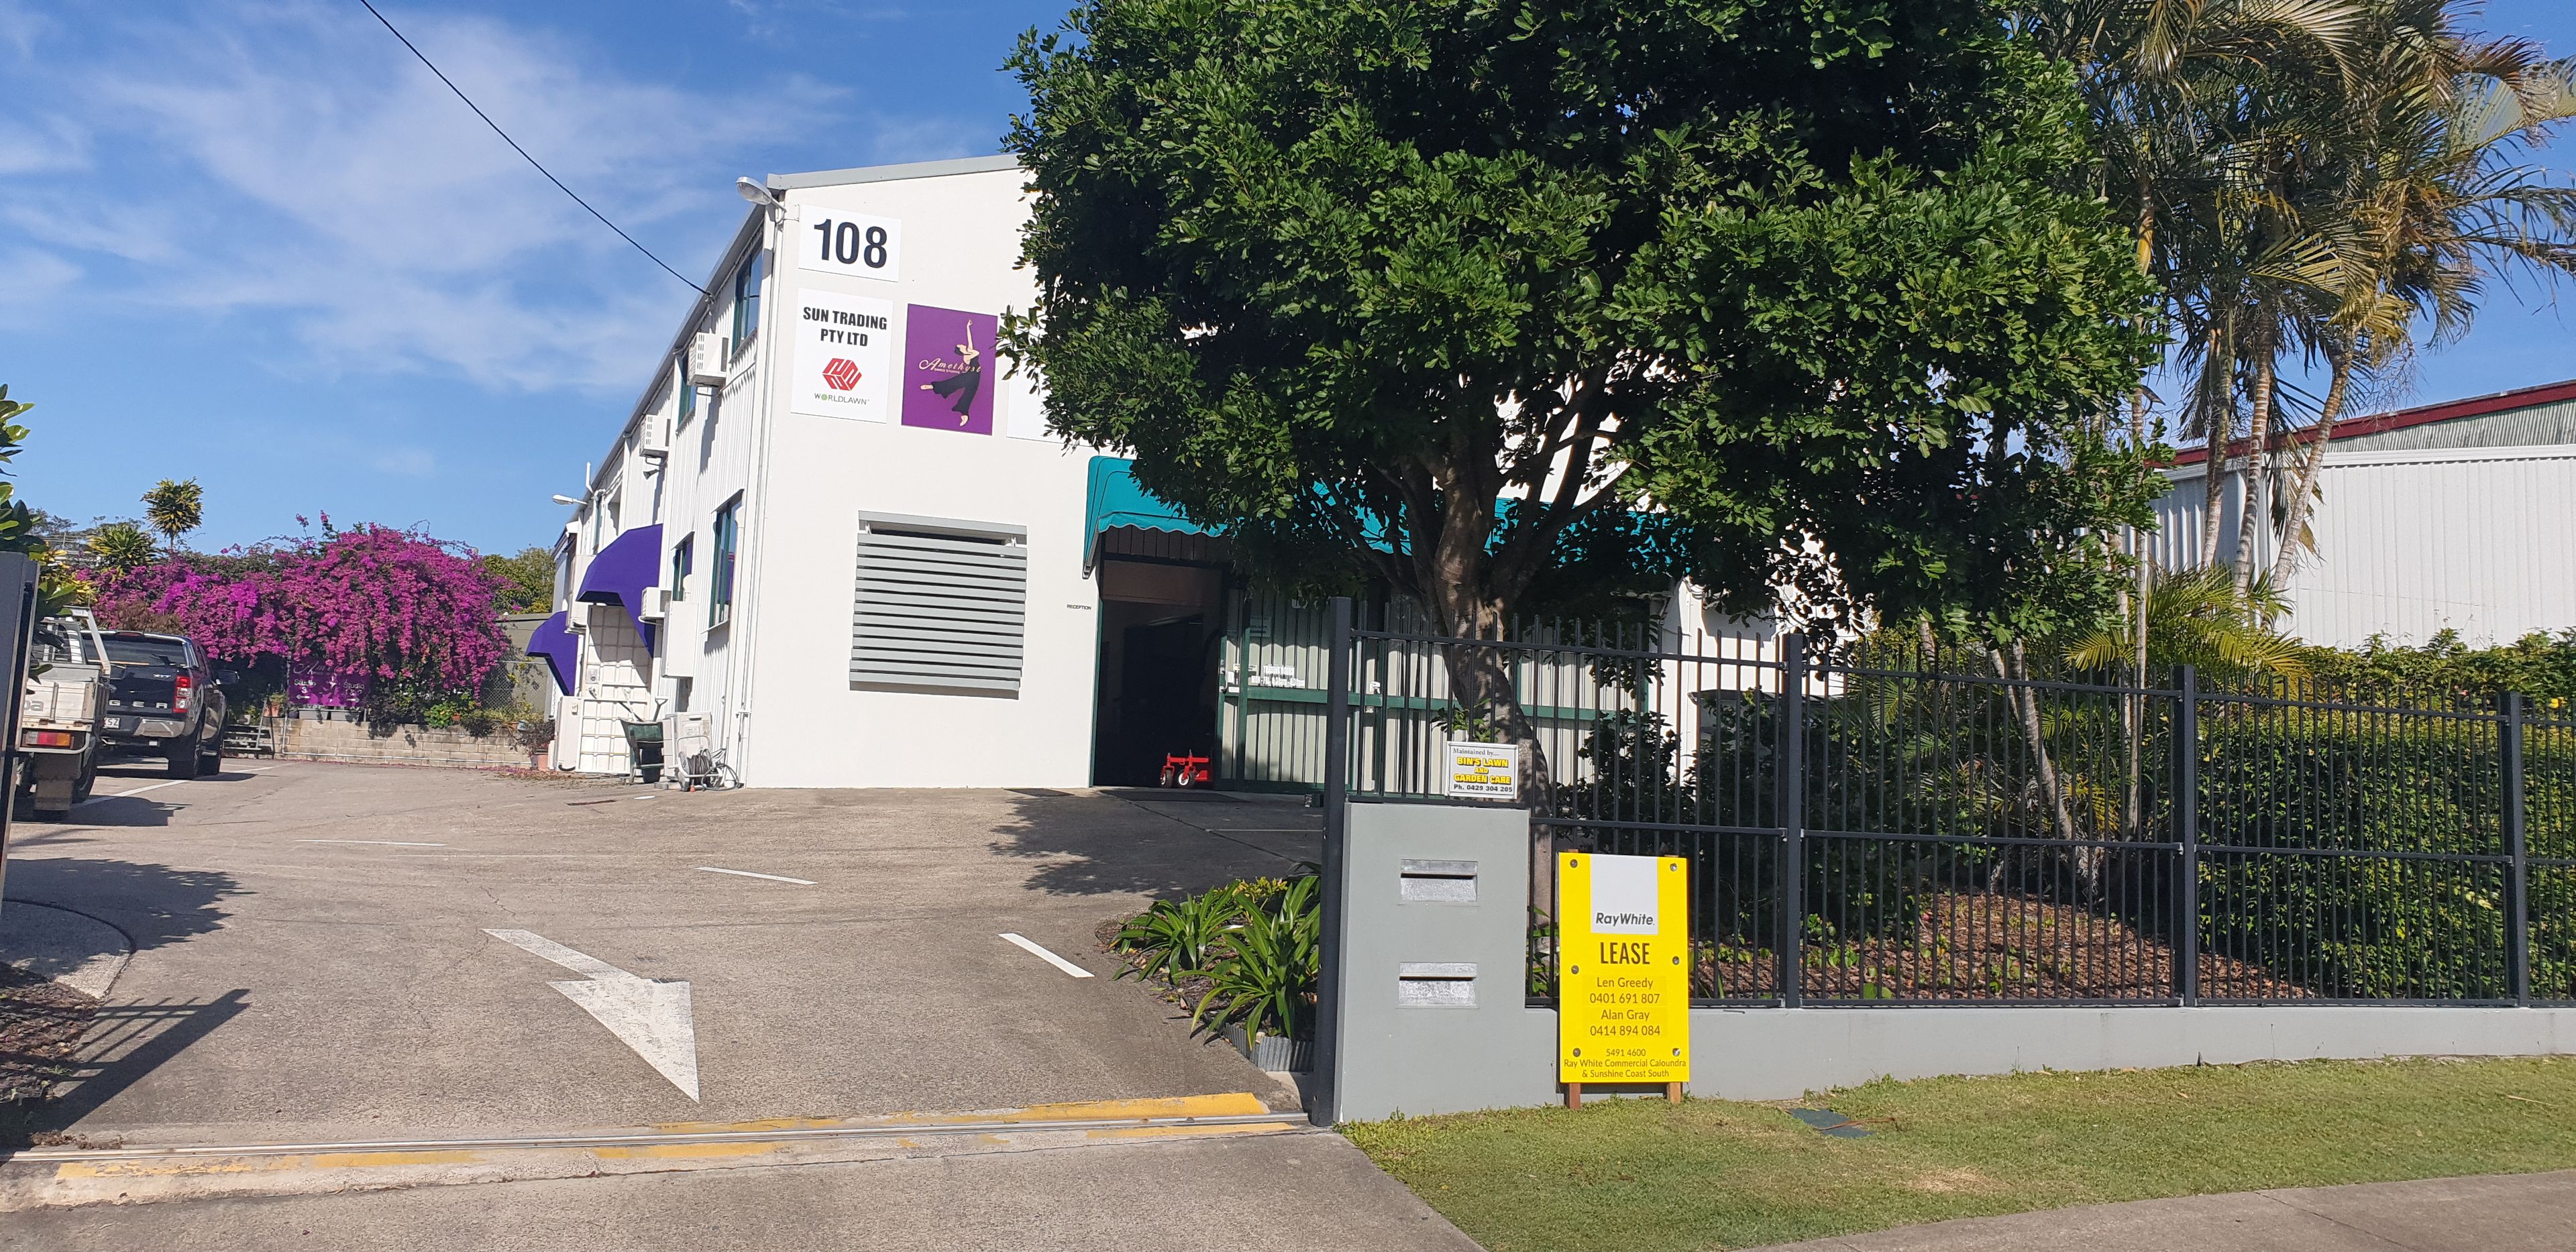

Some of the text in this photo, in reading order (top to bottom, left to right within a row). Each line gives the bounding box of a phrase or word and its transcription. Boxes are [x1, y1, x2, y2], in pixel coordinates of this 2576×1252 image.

[814, 219, 887, 268] 108
[803, 306, 888, 331] SUN TRADING
[820, 328, 868, 347] PTY LTD
[814, 393, 867, 405] WORLDLAWN
[294, 679, 317, 687] Studio
[343, 681, 365, 689] Studio
[1453, 748, 1485, 756] Maintained
[1457, 756, 1509, 767] BIN'S LAWN
[1454, 773, 1511, 785] GARDEN CARE
[1600, 942, 1650, 964] LEASE
[1597, 977, 1654, 990] Len Greedy
[1590, 993, 1660, 1004] 0401 691 807
[1601, 1009, 1650, 1022] Alan Gray
[1590, 1025, 1660, 1036] 0414 894 084
[1606, 1049, 1646, 1057] 5491 4600
[1564, 1059, 1686, 1068] Ray White Commercial Caloundra
[1582, 1070, 1670, 1078] & Sunshine Coast South
